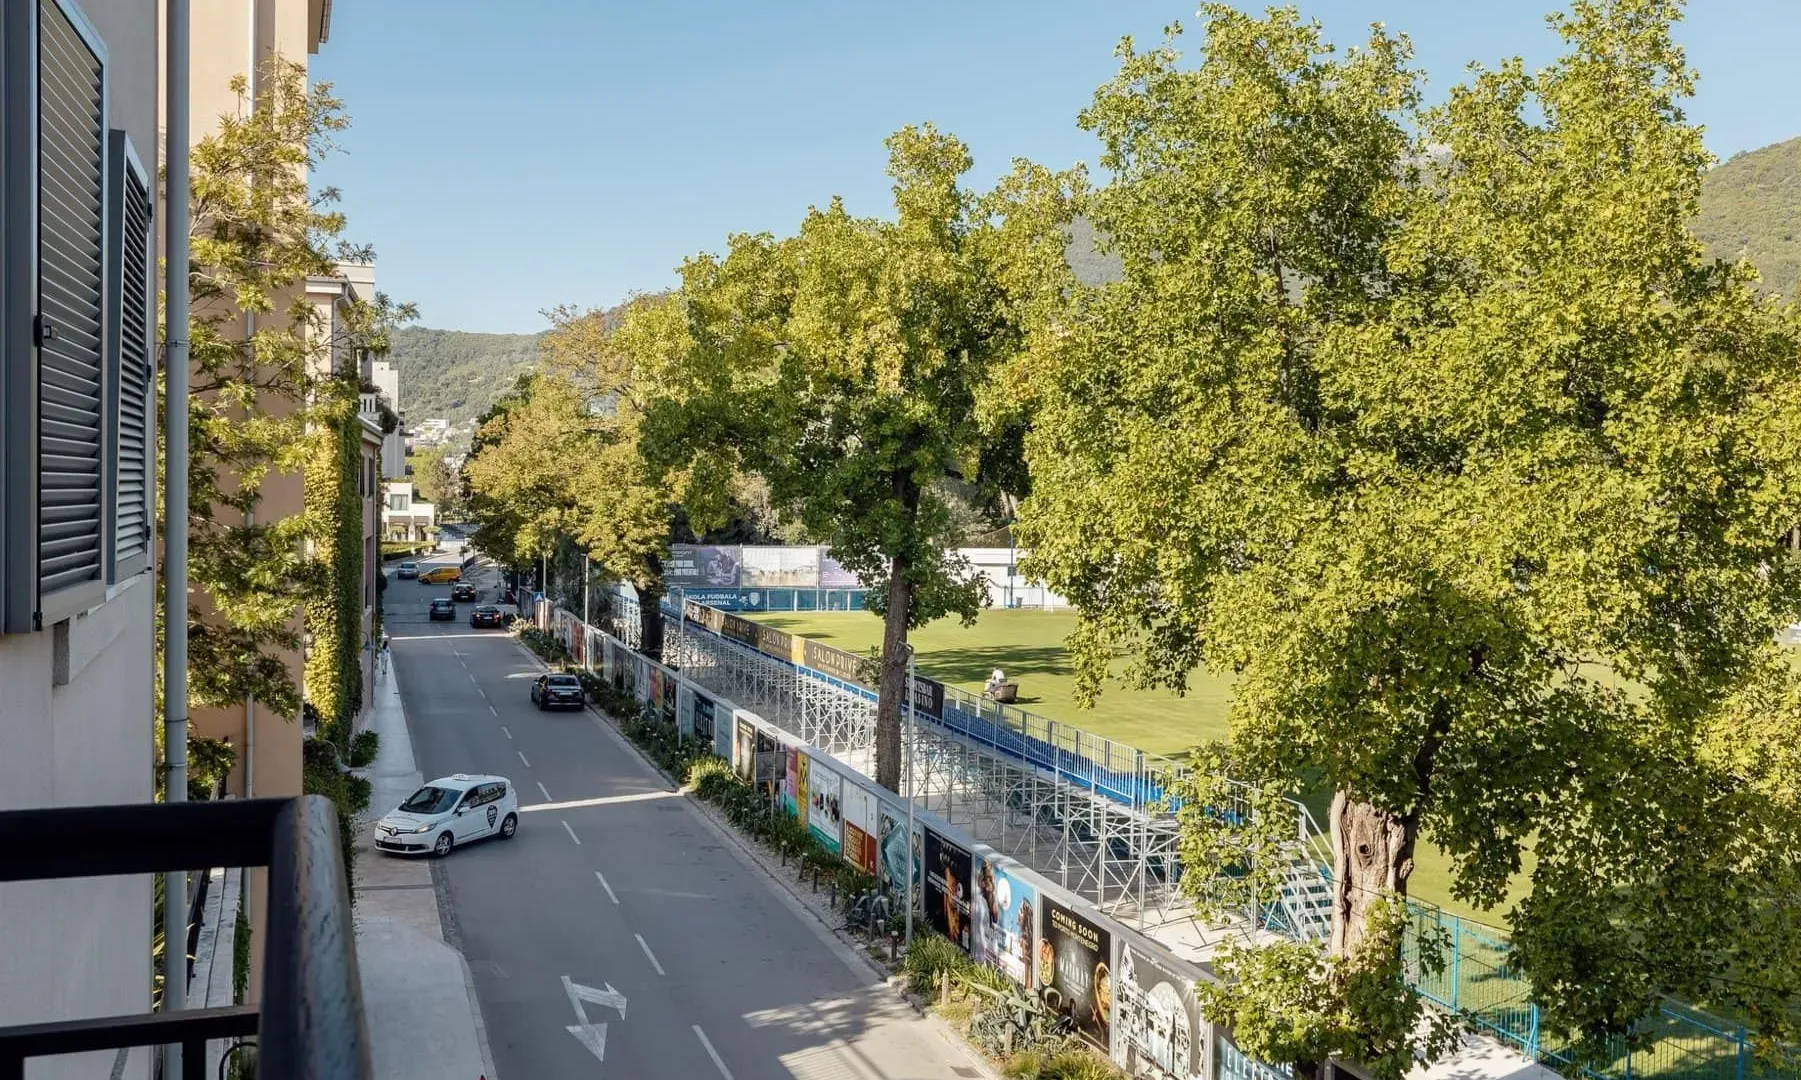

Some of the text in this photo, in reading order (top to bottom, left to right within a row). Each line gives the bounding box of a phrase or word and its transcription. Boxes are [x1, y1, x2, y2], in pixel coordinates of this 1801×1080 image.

[813, 646, 836, 666] SALON
[1051, 909, 1099, 943] COMING SOON
